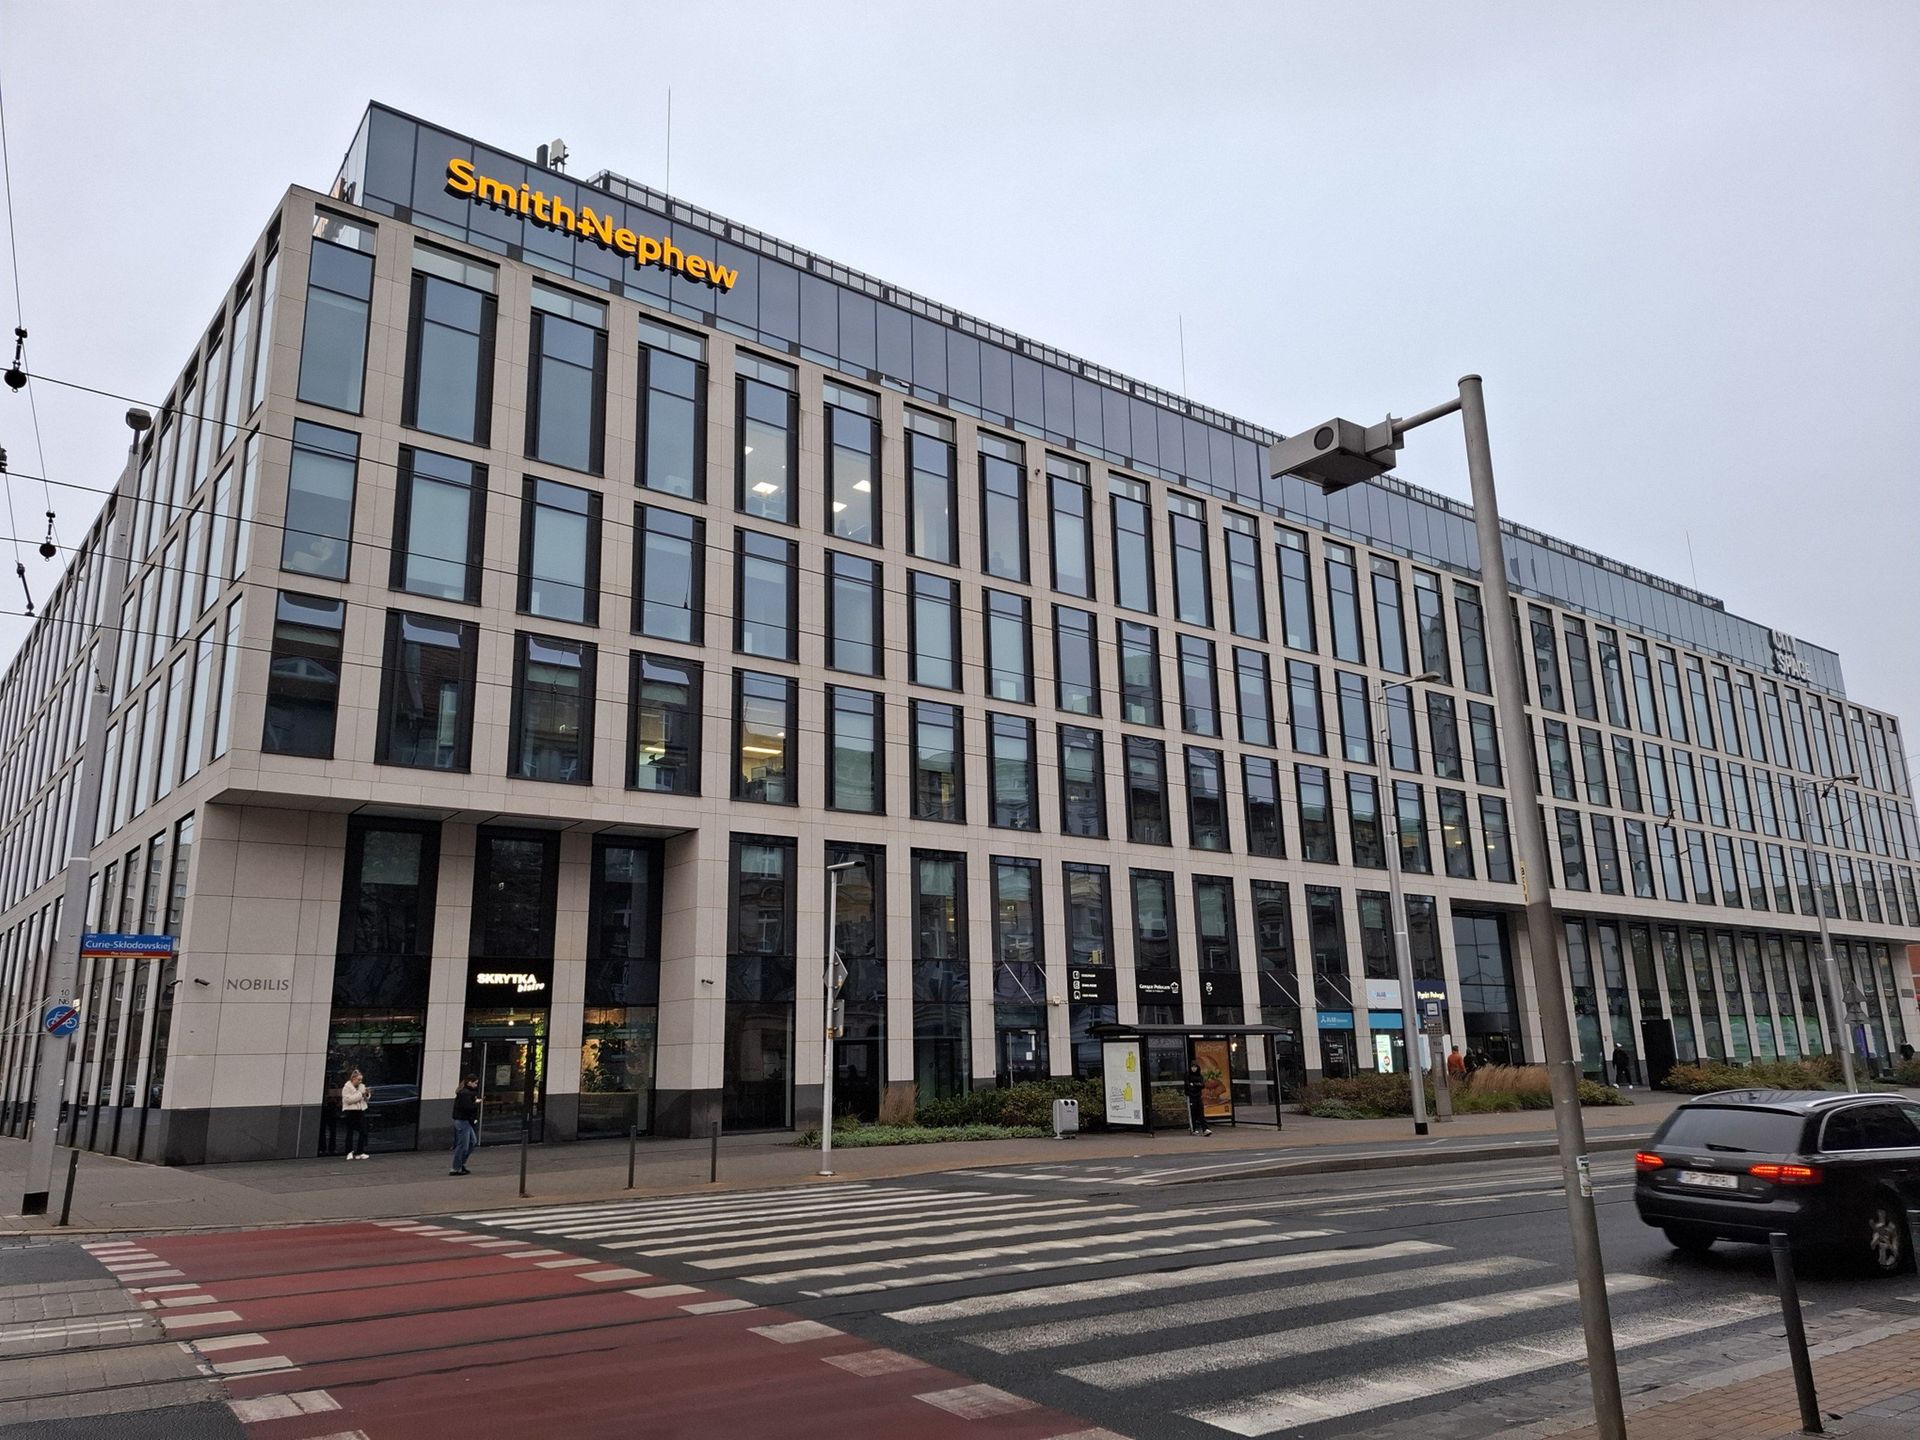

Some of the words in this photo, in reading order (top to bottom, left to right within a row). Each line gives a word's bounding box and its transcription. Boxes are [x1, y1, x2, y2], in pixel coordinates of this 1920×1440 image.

[85, 940, 171, 951] Curie-Skłodowskiej
[477, 973, 537, 984] SKRYTKA
[226, 979, 289, 991] NOBILIS
